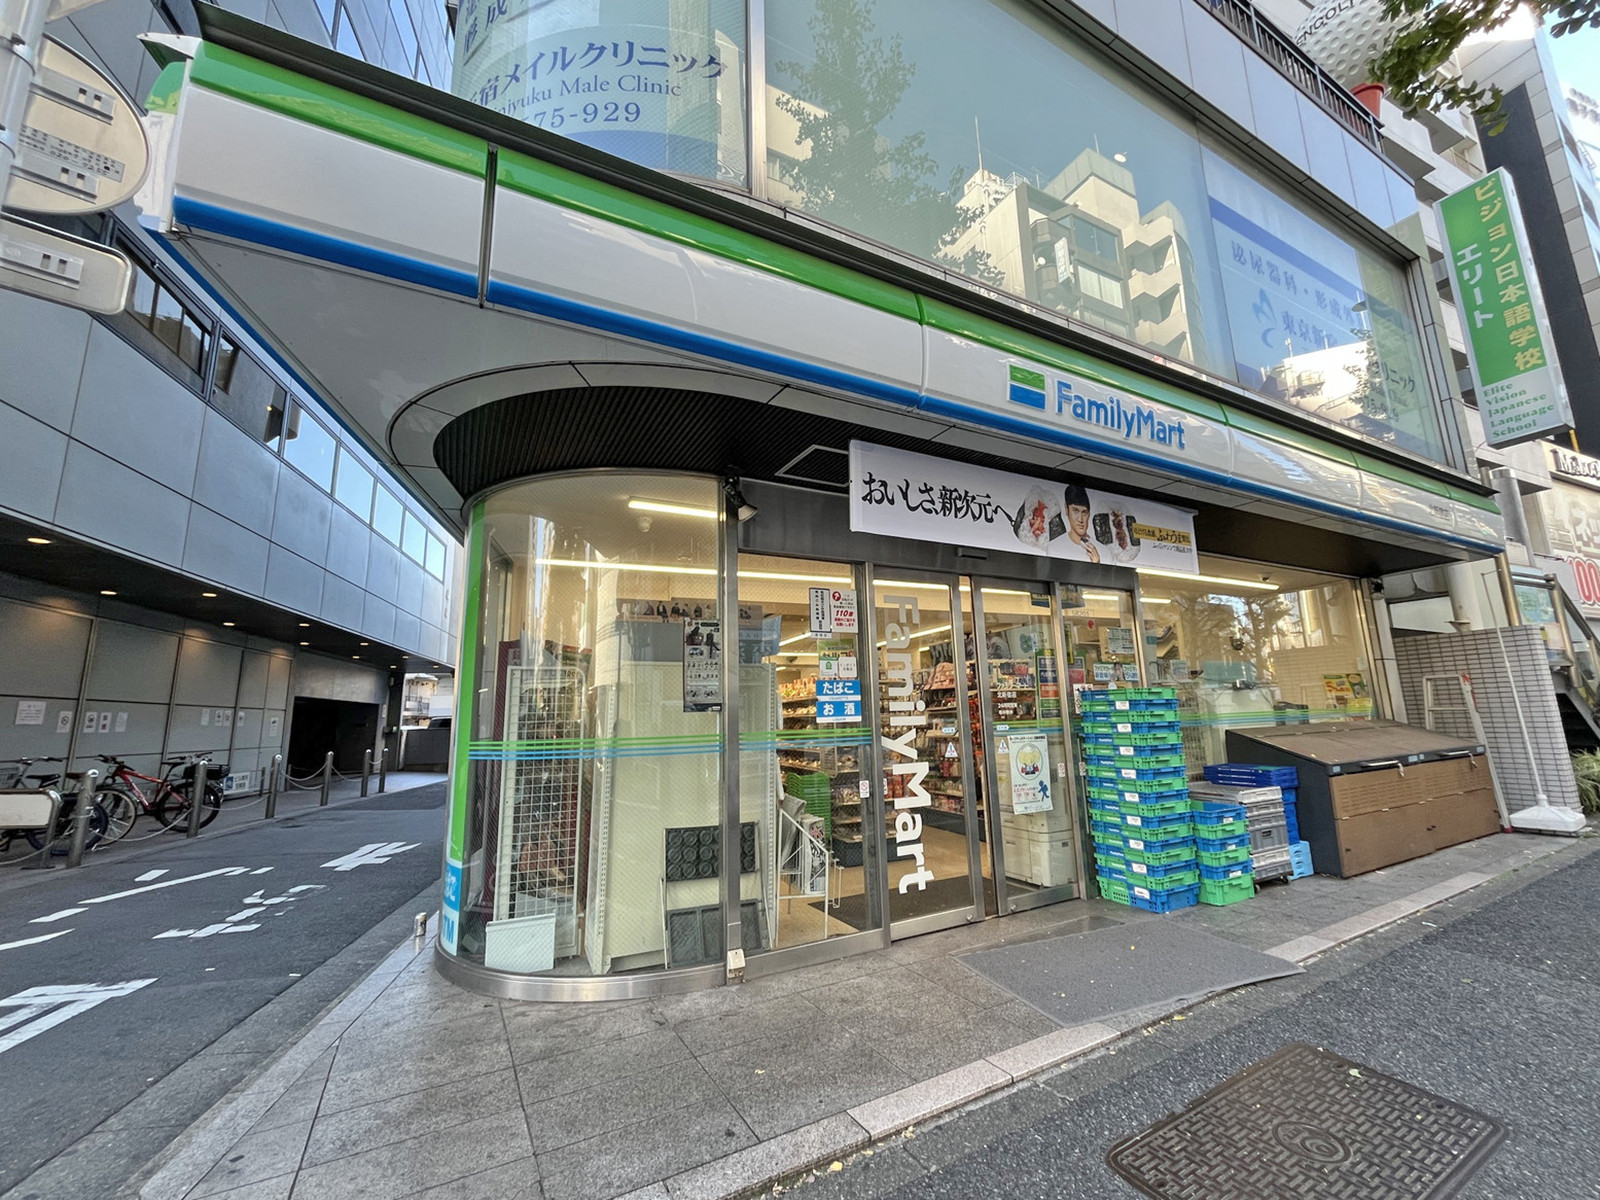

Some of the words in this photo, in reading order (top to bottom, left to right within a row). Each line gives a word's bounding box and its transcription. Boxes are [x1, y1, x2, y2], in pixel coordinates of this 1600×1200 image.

[469, 40, 728, 106] 宿メイルクリニック
[560, 75, 610, 97] Male
[617, 74, 682, 97] Clinic
[521, 102, 642, 128] 75-929
[1456, 242, 1494, 329] エリート
[1475, 177, 1546, 372] ビジョン日本語学校
[1483, 382, 1513, 398] Elite
[1485, 389, 1527, 406] Vision
[1056, 379, 1185, 450] FamilyMart
[1488, 393, 1547, 418] Japanese
[1490, 403, 1554, 428] Language
[1492, 419, 1537, 438] School
[861, 472, 1016, 527] おいしさ新次元へ
[1564, 557, 1600, 604] 00
[822, 682, 855, 695] たばこ
[881, 594, 935, 894] FamilyMart
